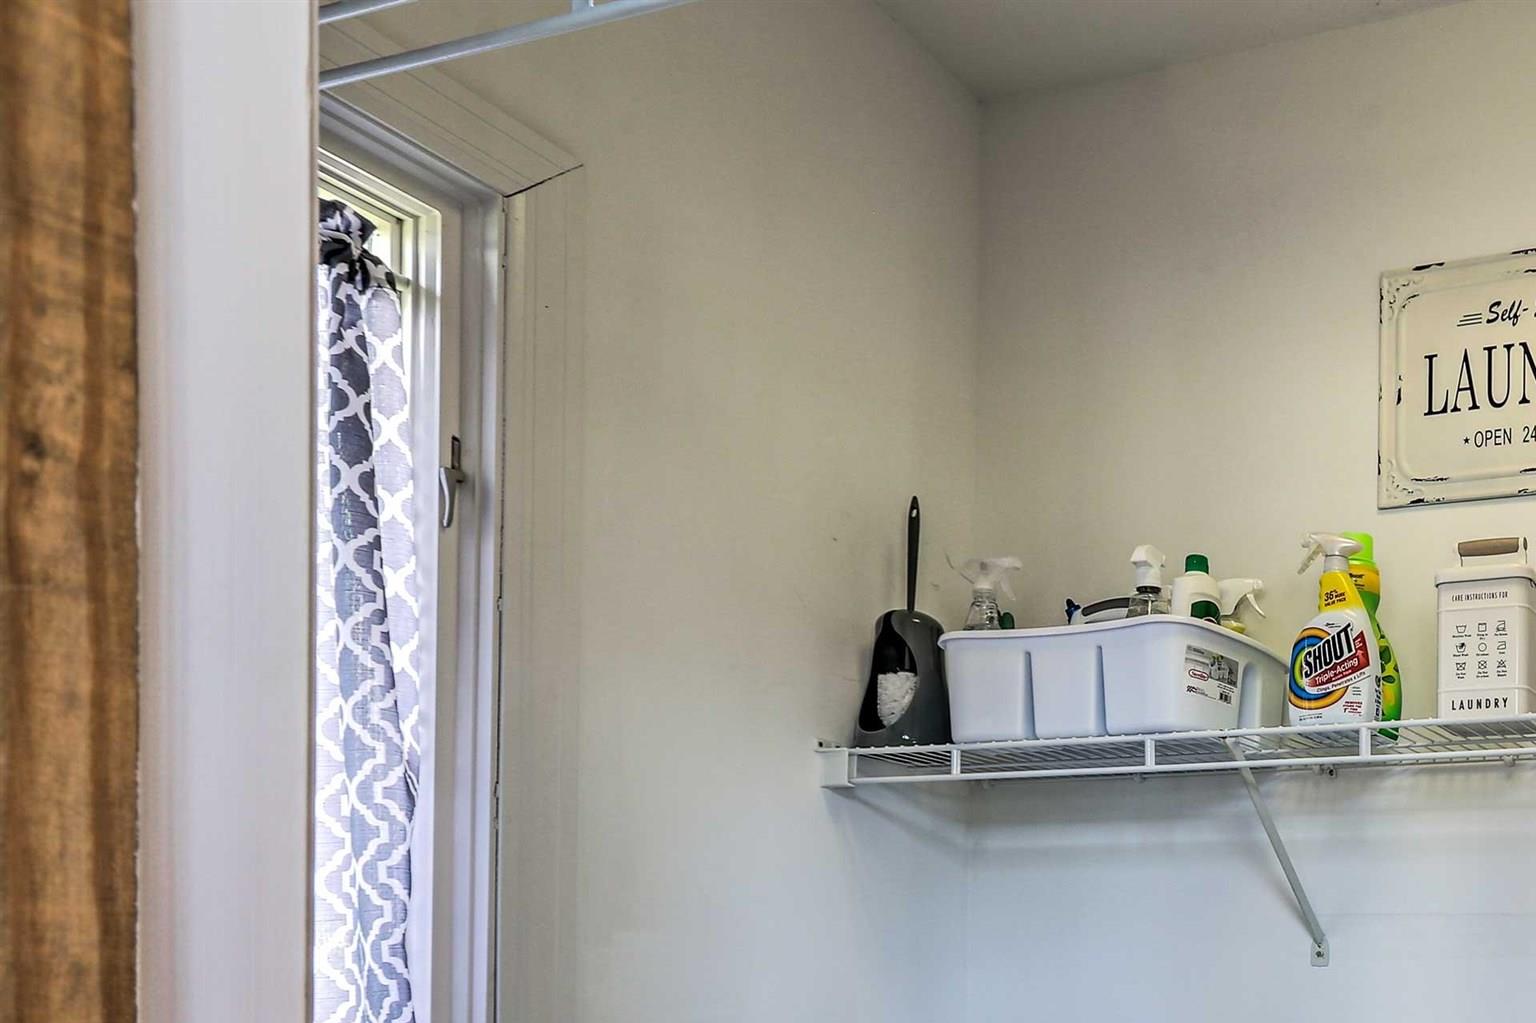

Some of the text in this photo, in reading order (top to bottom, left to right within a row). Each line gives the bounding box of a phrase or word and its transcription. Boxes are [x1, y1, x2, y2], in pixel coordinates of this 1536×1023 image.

[1474, 427, 1512, 448] OPEN
[1451, 591, 1508, 602] CARE INSTRUCTIONS FOR
[1303, 622, 1355, 679] SHOUT
[1315, 657, 1359, 685] Triple-Acting
[1451, 697, 1508, 710] LAUNDRY
